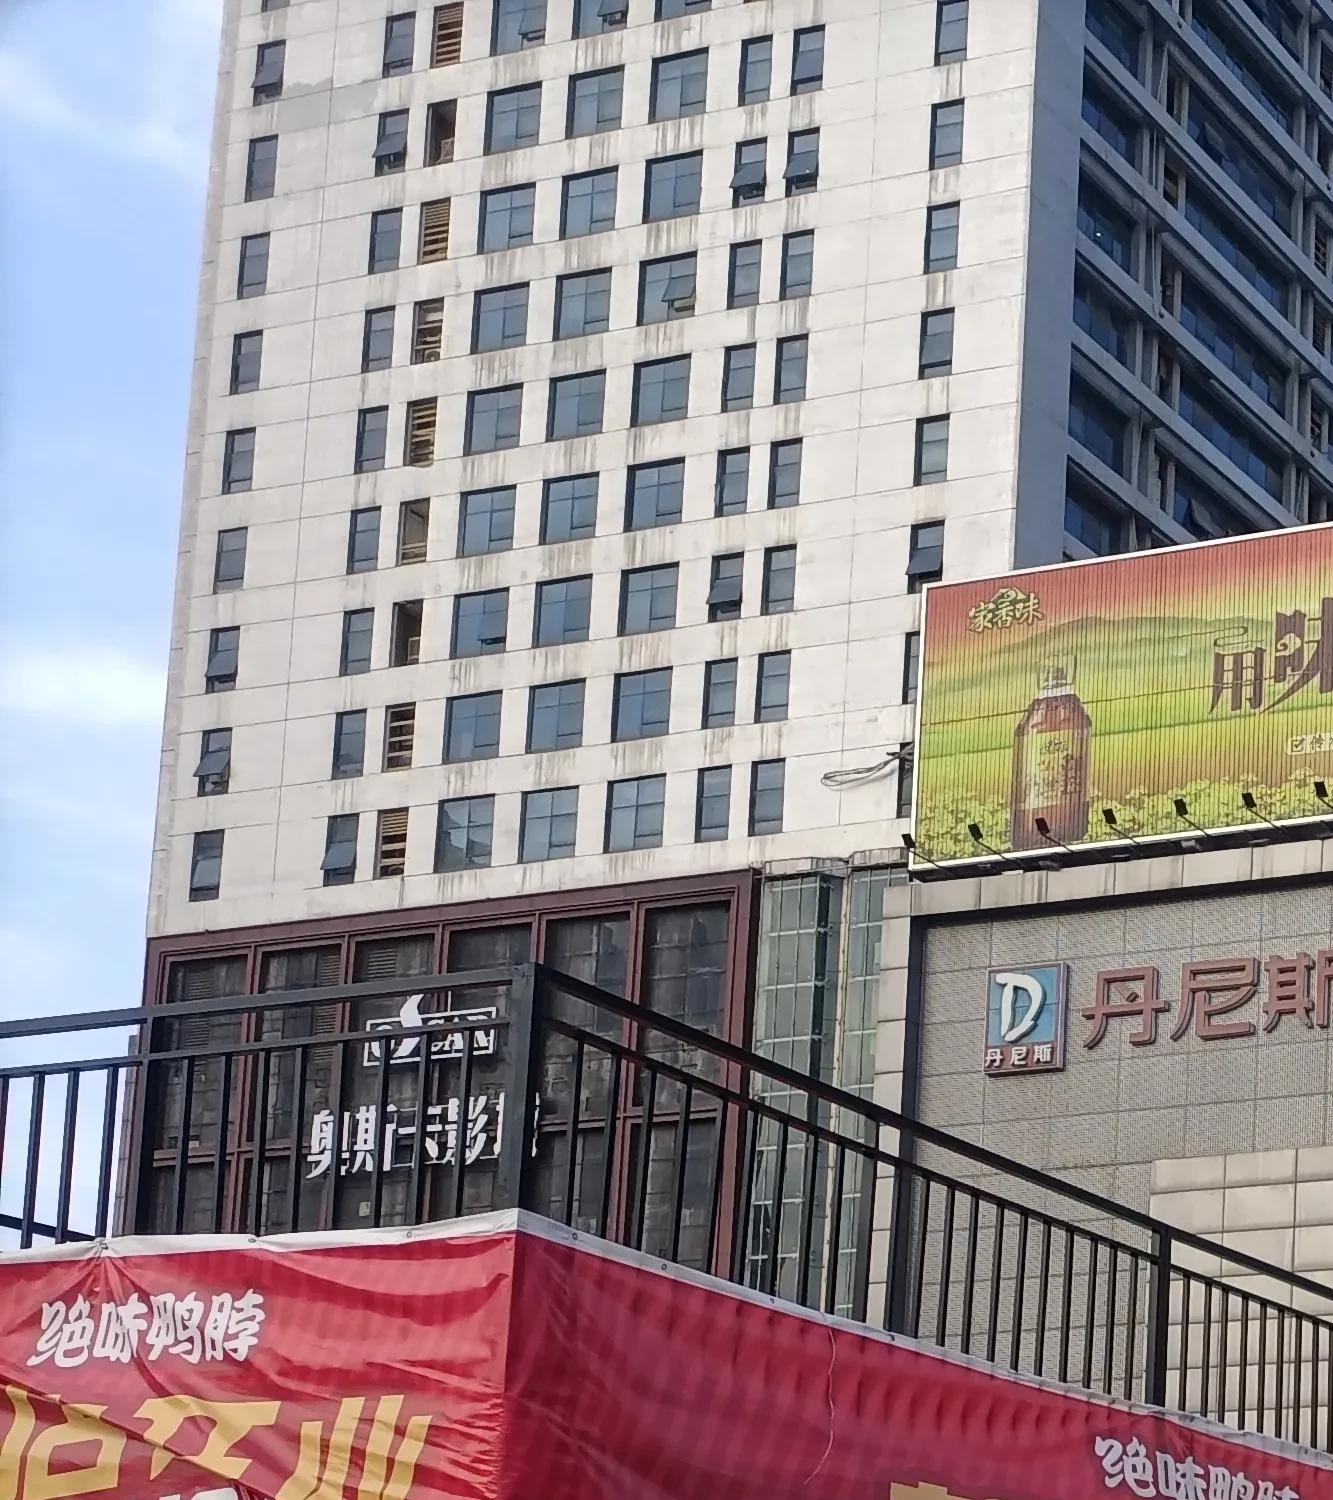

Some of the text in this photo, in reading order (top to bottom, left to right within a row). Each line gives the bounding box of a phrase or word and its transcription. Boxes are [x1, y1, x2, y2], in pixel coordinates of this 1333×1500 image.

[969, 590, 1043, 633] 家香味
[984, 1043, 1053, 1069] 丹尼斯
[27, 1288, 266, 1368] 绝味鸭脖
